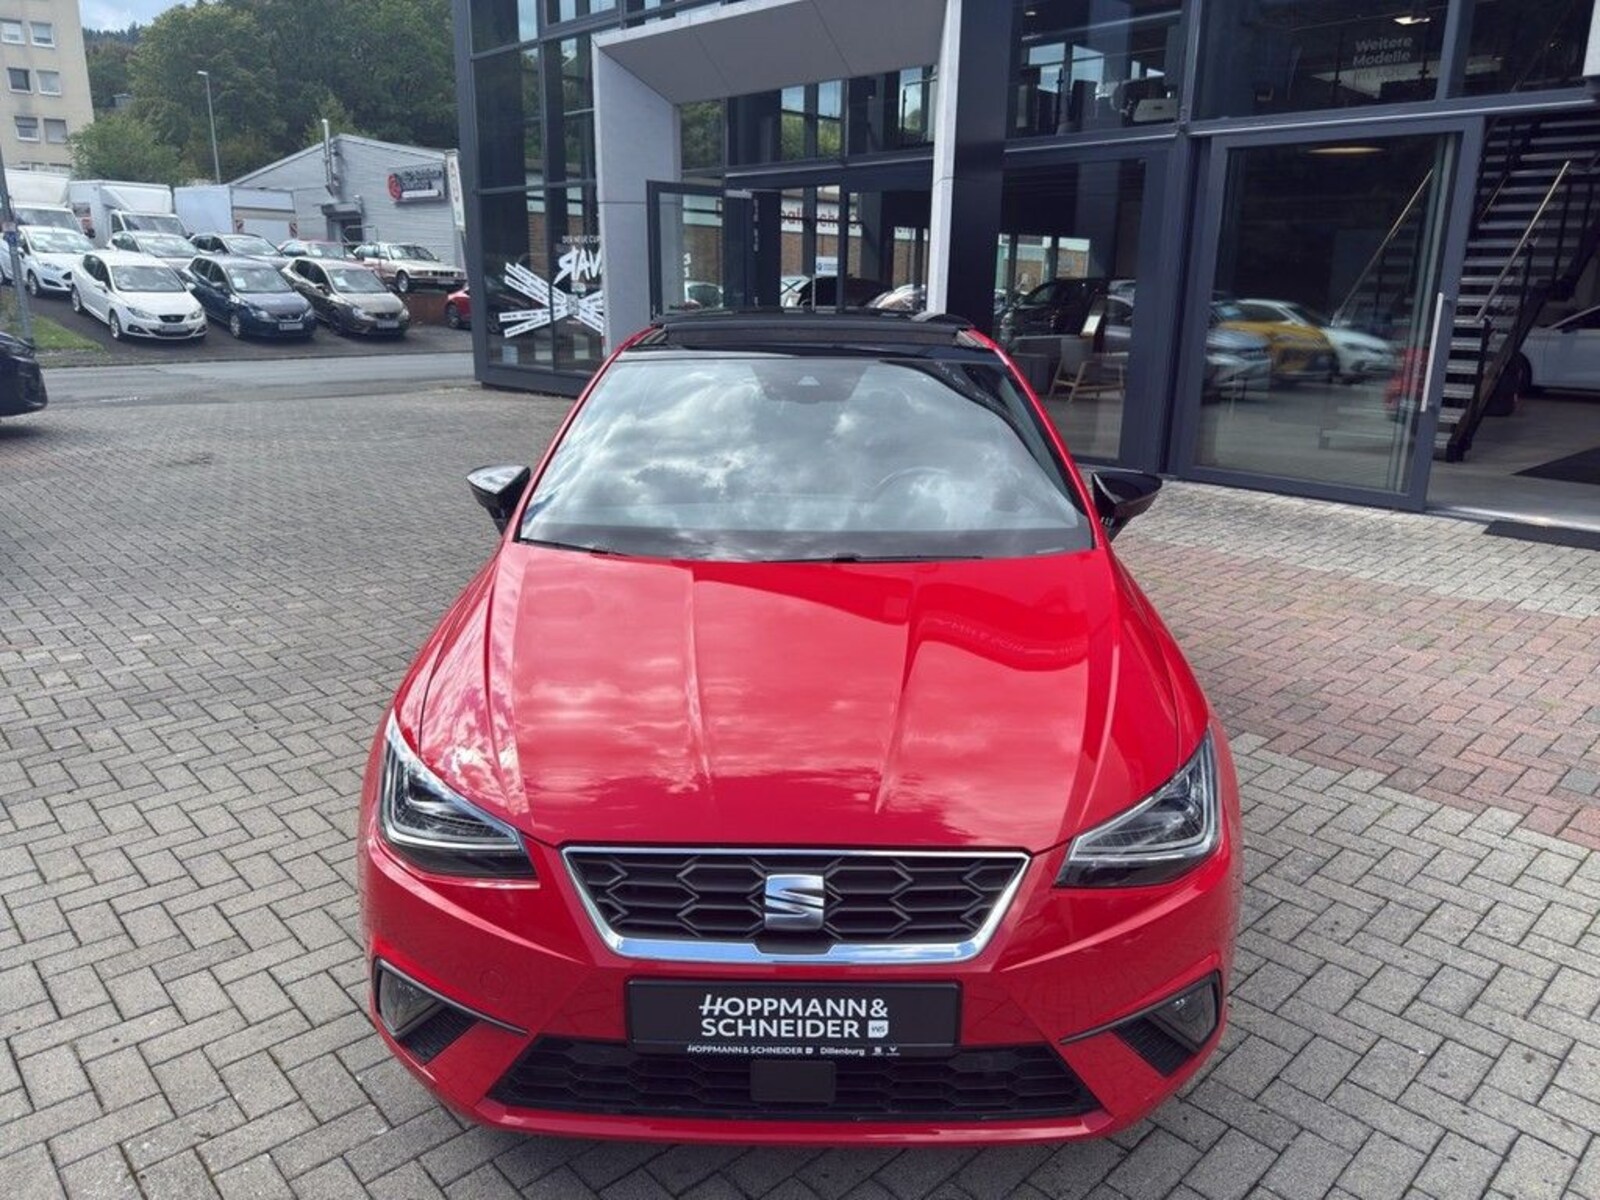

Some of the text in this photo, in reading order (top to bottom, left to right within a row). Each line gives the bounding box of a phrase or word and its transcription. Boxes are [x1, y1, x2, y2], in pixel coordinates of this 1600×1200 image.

[1355, 36, 1413, 52] Weitere
[1352, 49, 1411, 67] Modelle
[701, 1018, 860, 1038] SCHNEIDER
[750, 1045, 803, 1055] SCHNEIDER
[820, 1047, 865, 1056] Dillenburg
